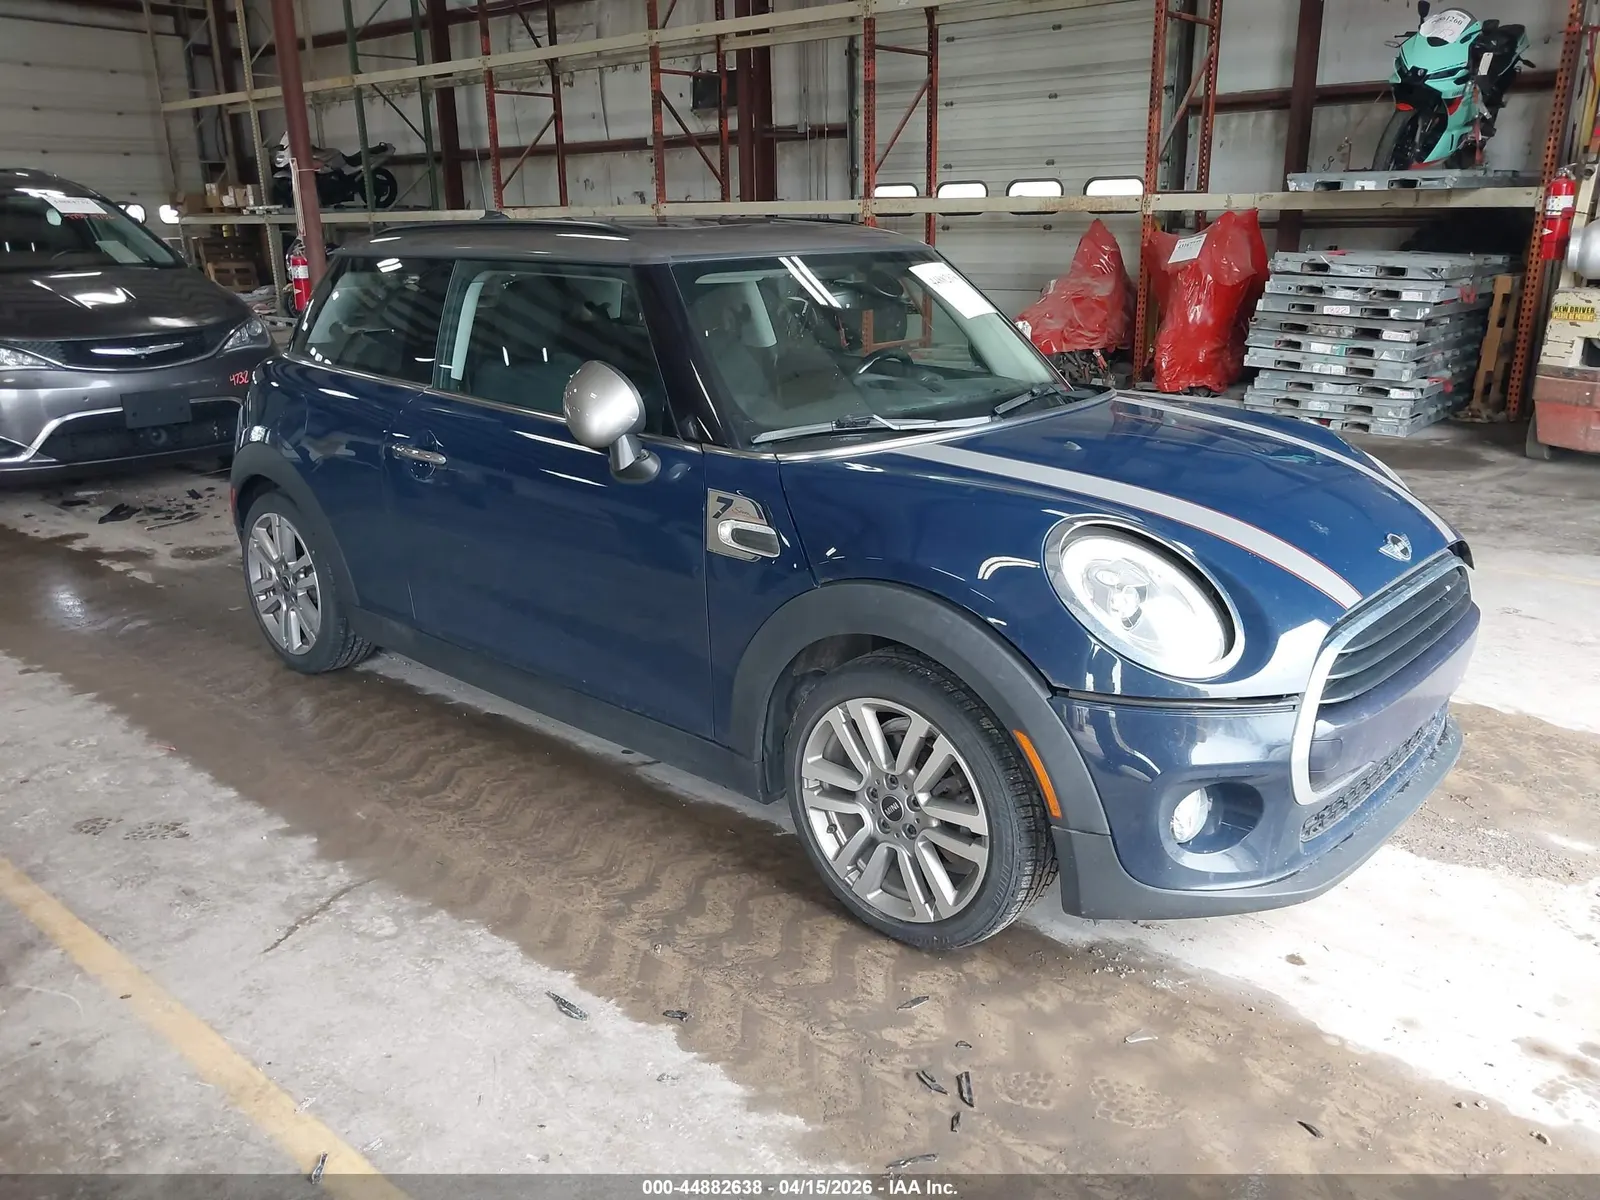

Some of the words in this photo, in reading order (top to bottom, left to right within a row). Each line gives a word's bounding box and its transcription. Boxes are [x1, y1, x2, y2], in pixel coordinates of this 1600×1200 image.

[229, 370, 249, 386] 4732
[712, 496, 734, 520] 7
[884, 802, 900, 815] MINI
